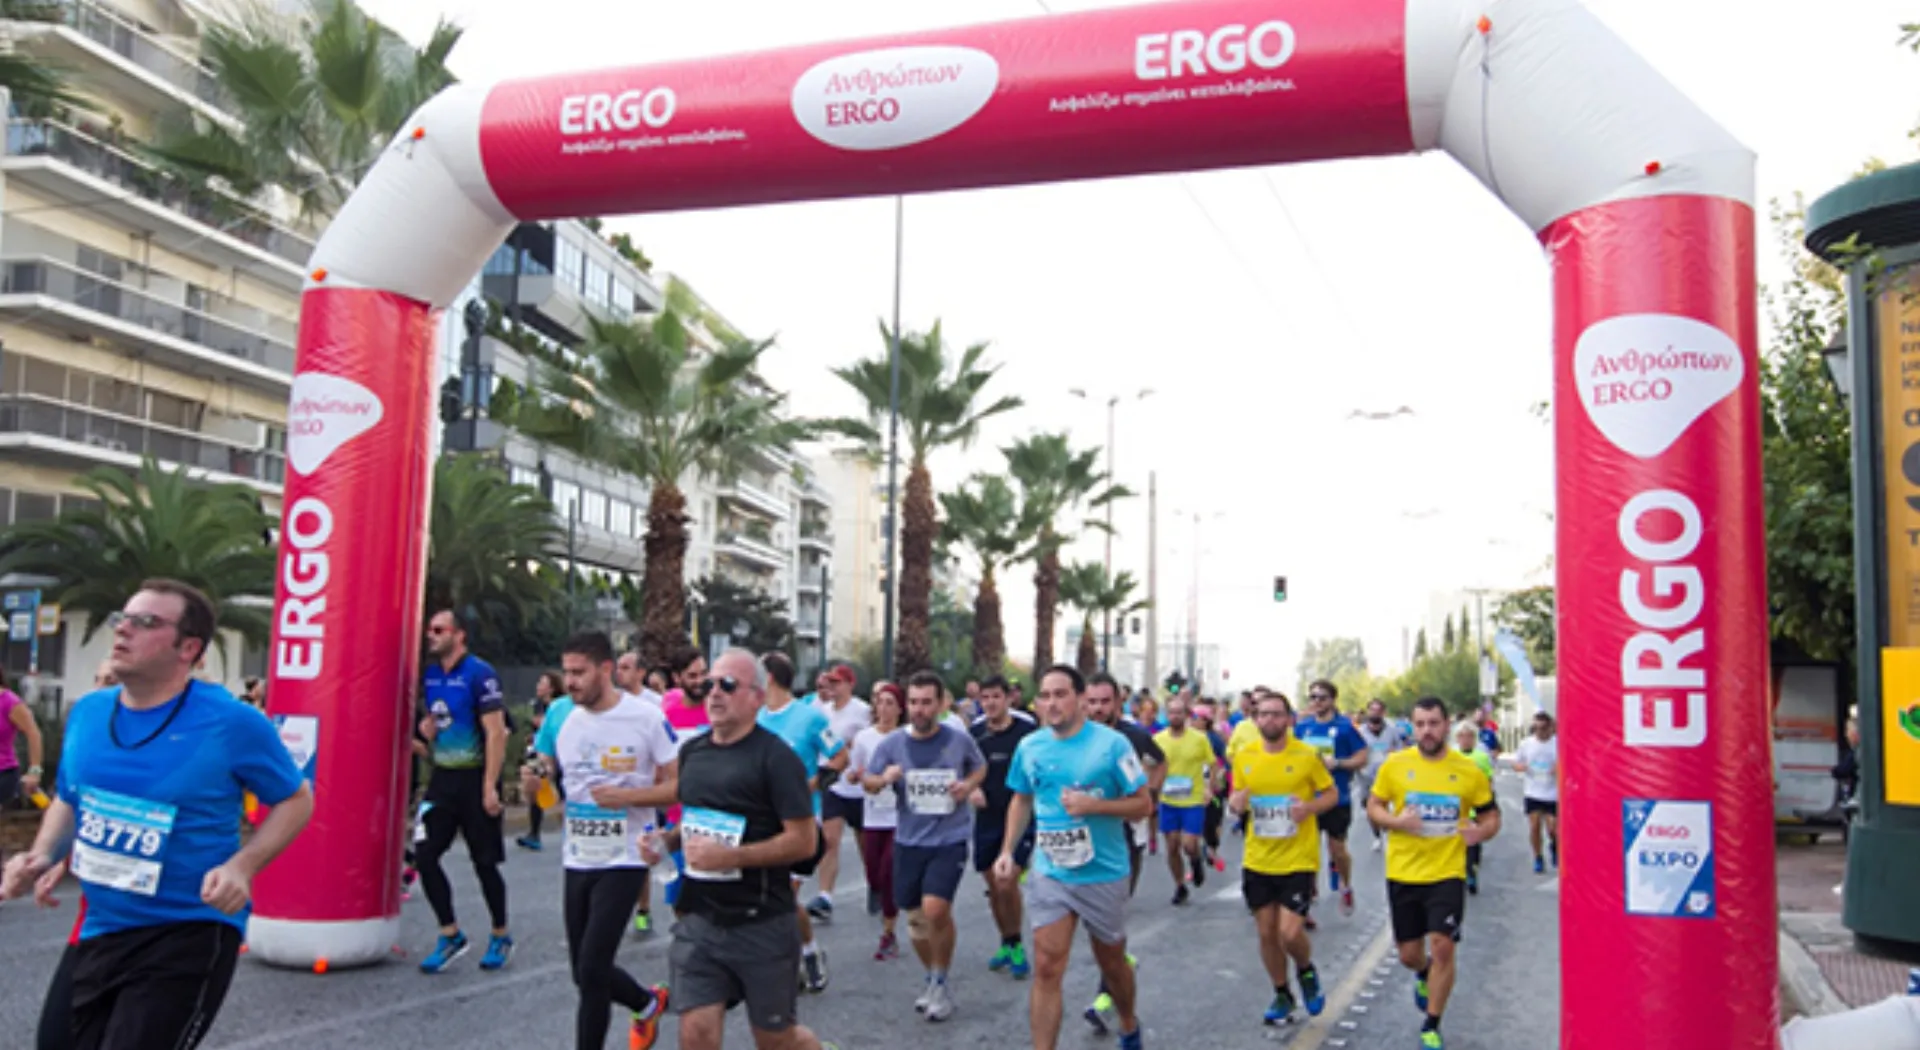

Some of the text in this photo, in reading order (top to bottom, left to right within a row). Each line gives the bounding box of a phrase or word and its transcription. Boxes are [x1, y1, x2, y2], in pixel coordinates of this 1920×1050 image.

[1135, 20, 1295, 80] ERGO
[824, 63, 963, 95] Ανθρώπων
[560, 86, 677, 135] ERGO
[825, 98, 900, 127] ERGO
[1591, 344, 1734, 377] Ανθρώπων
[1592, 377, 1673, 407] ERGO
[276, 497, 334, 681] ERGO
[1618, 489, 1707, 747] ERGO
[78, 809, 161, 857] 28779
[1646, 826, 1690, 840] ERGO
[1639, 851, 1698, 868] EXPO
